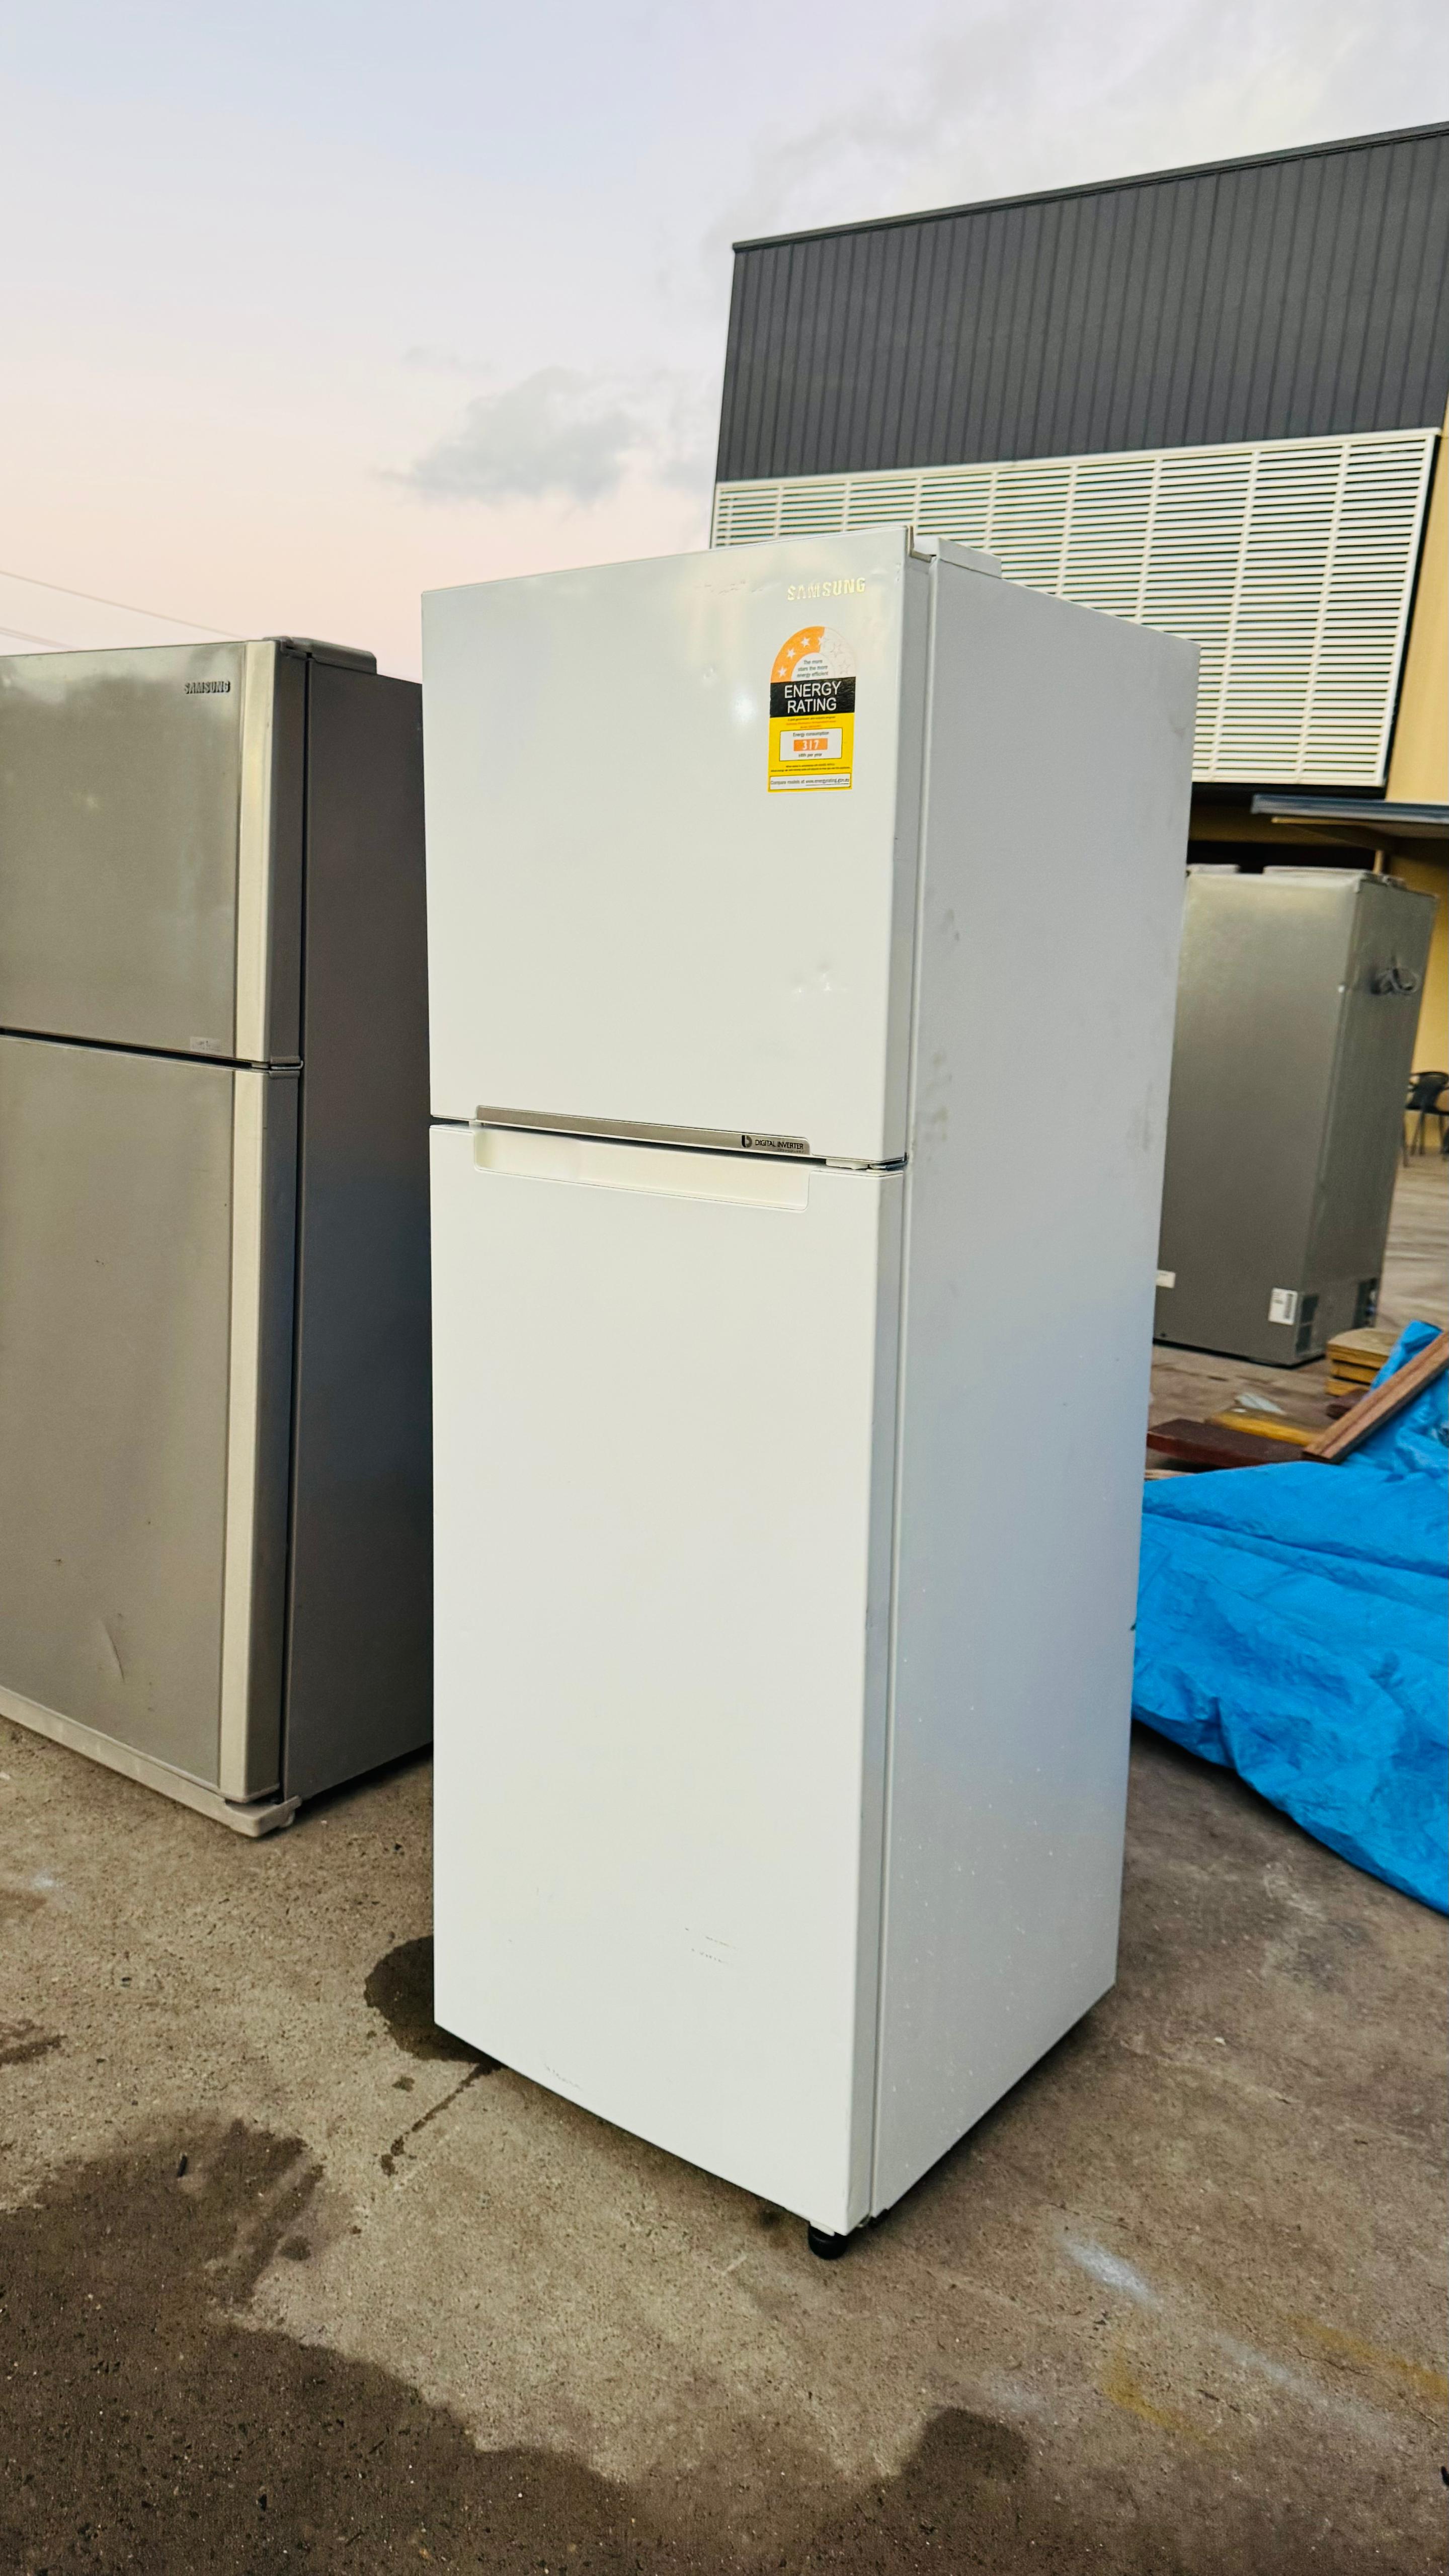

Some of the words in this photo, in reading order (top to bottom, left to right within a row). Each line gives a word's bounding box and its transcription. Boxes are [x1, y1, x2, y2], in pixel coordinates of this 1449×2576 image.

[787, 578, 865, 601] SAMSUNG
[185, 681, 230, 694] SAMSUNG
[784, 681, 842, 698] ENERGY
[787, 697, 837, 713] RATING
[802, 740, 820, 750] 317
[777, 1141, 803, 1149] INVERTER
